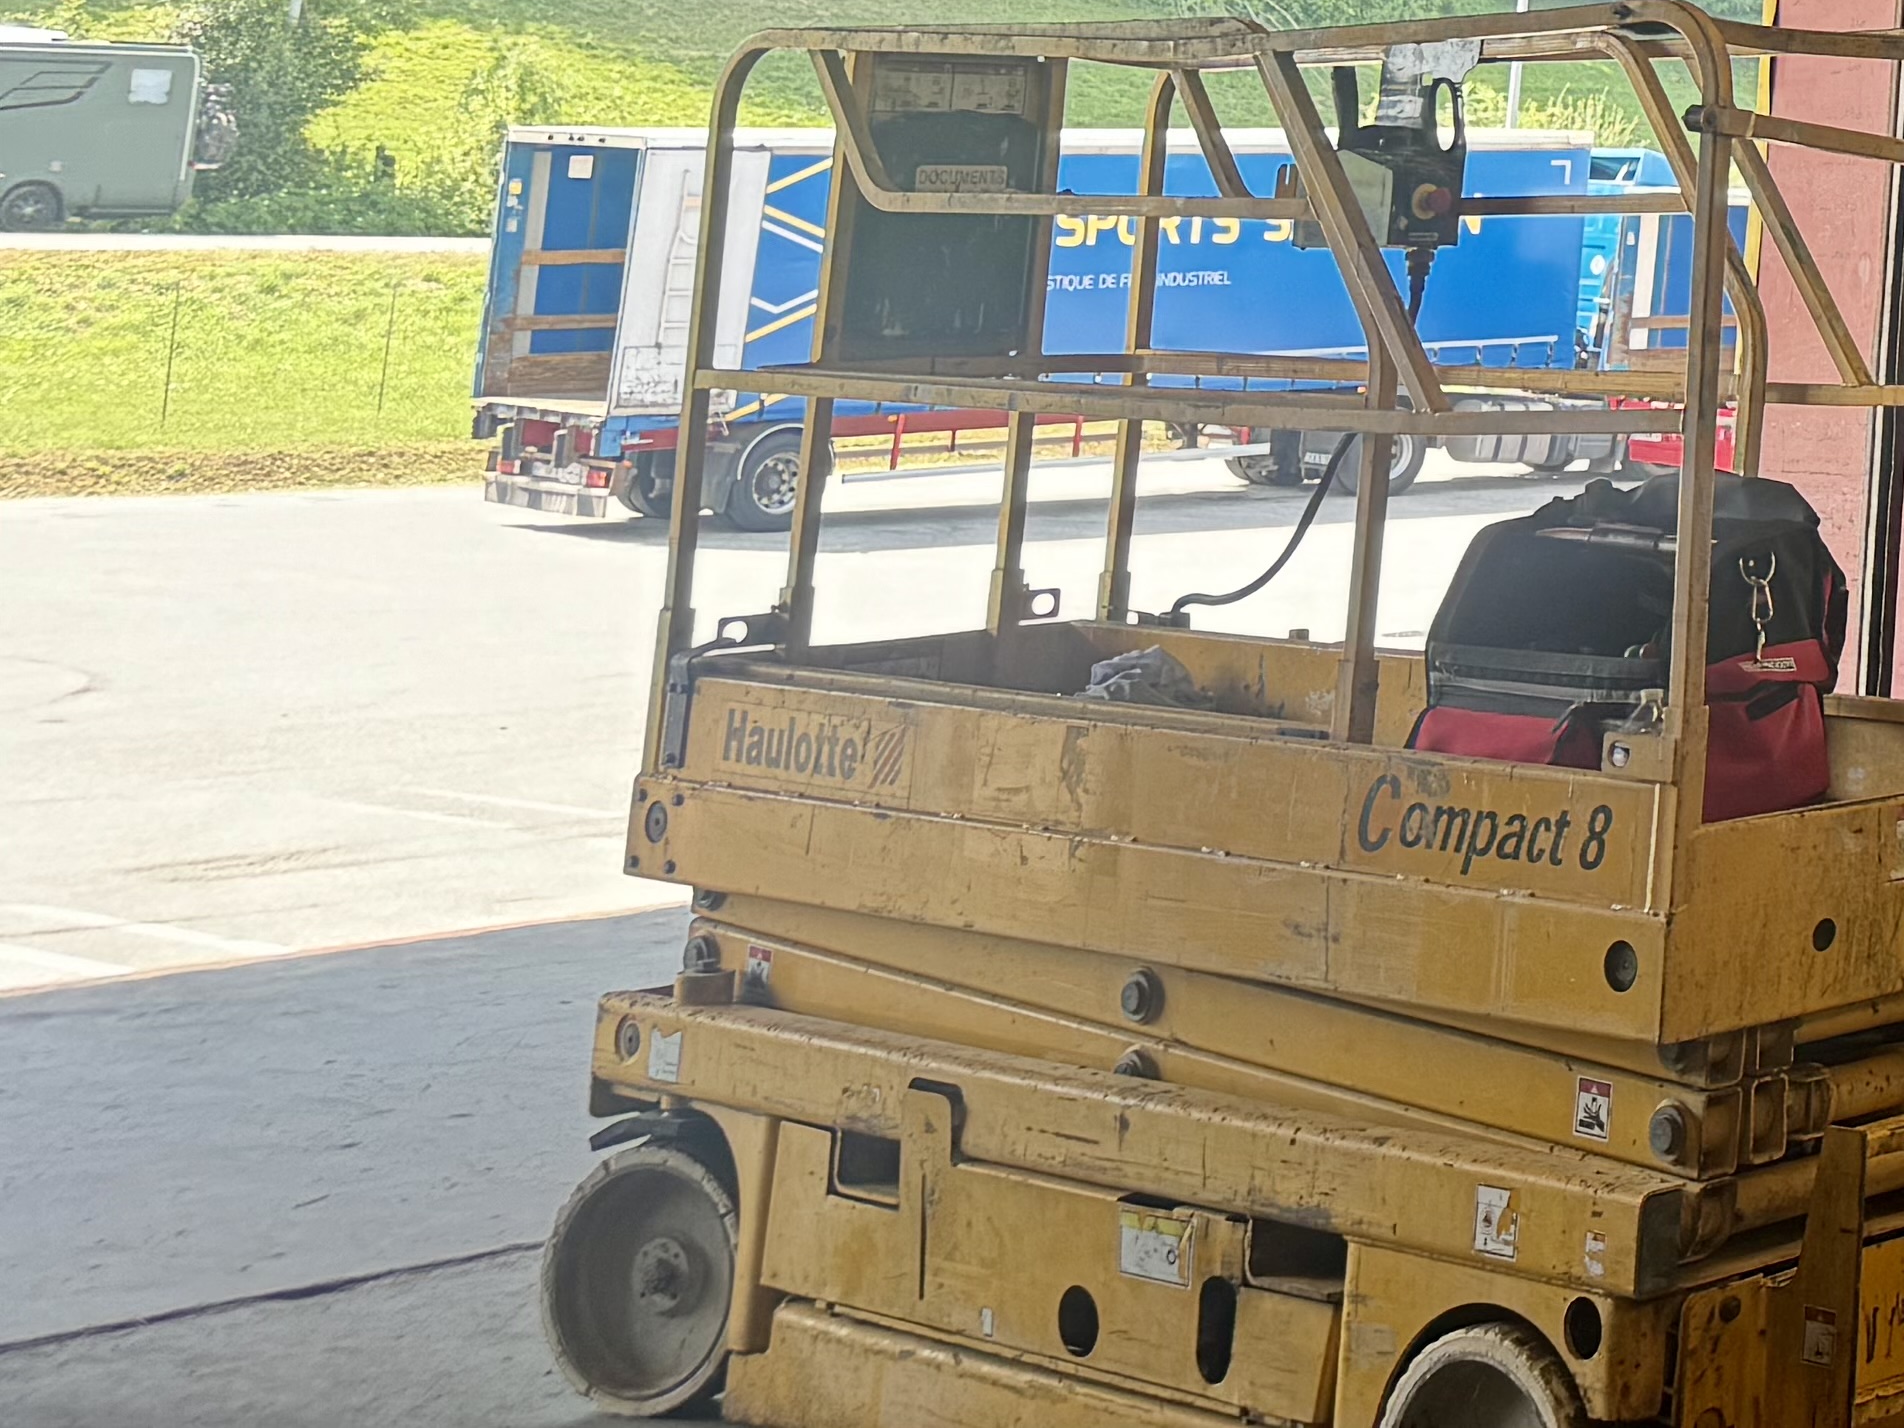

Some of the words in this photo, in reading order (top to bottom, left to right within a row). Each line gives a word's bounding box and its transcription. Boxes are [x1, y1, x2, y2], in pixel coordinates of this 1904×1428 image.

[918, 169, 1006, 186] DOCUMENTS
[1099, 273, 1117, 288] DE
[723, 708, 858, 780] Haulotte
[1357, 773, 1571, 875] Compact
[1579, 804, 1613, 870] 8
